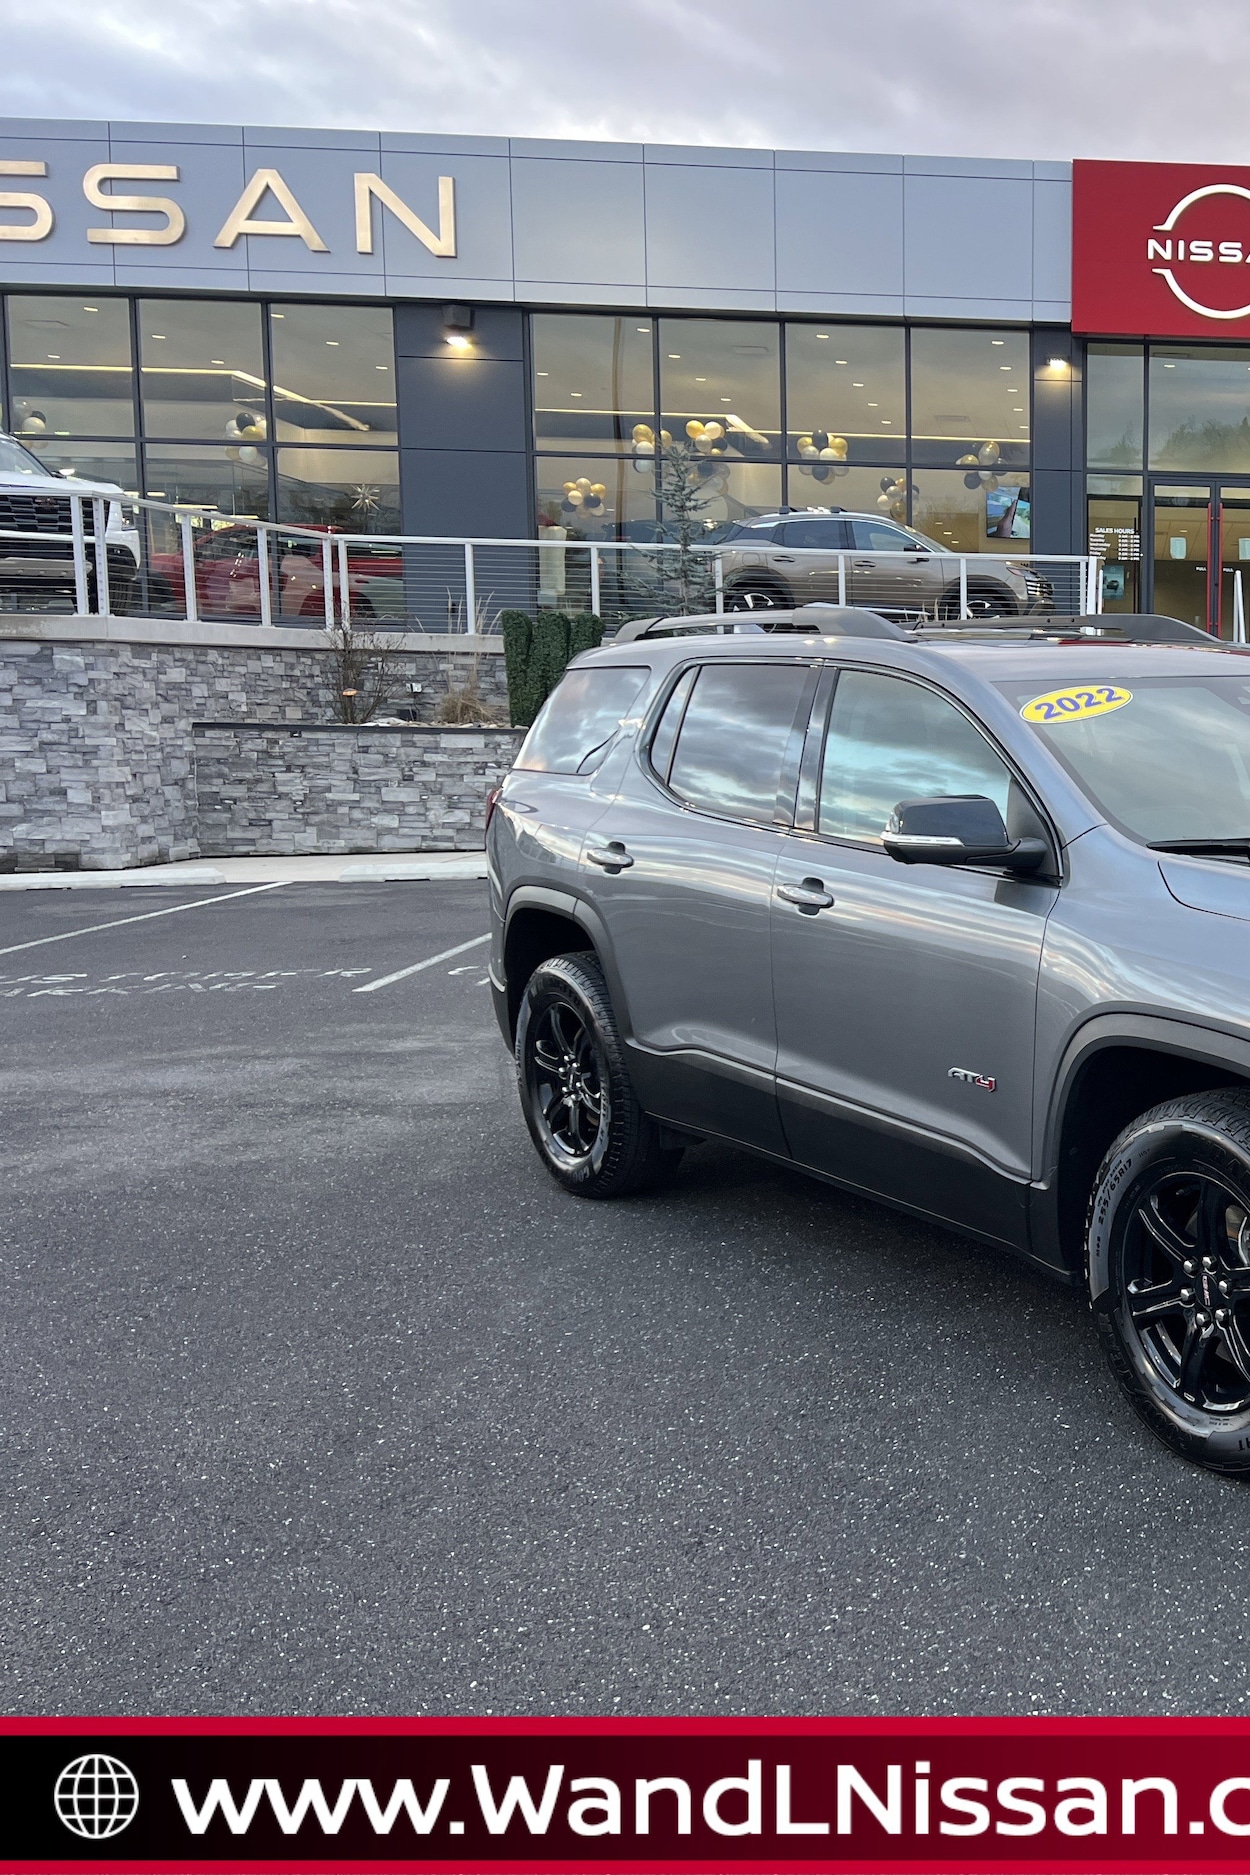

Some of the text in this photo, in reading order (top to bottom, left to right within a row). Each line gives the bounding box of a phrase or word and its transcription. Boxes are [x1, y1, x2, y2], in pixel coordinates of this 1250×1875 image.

[1034, 687, 1125, 720] 2022
[947, 1066, 996, 1093] AT4
[1098, 1158, 1132, 1225] 255/65R17
